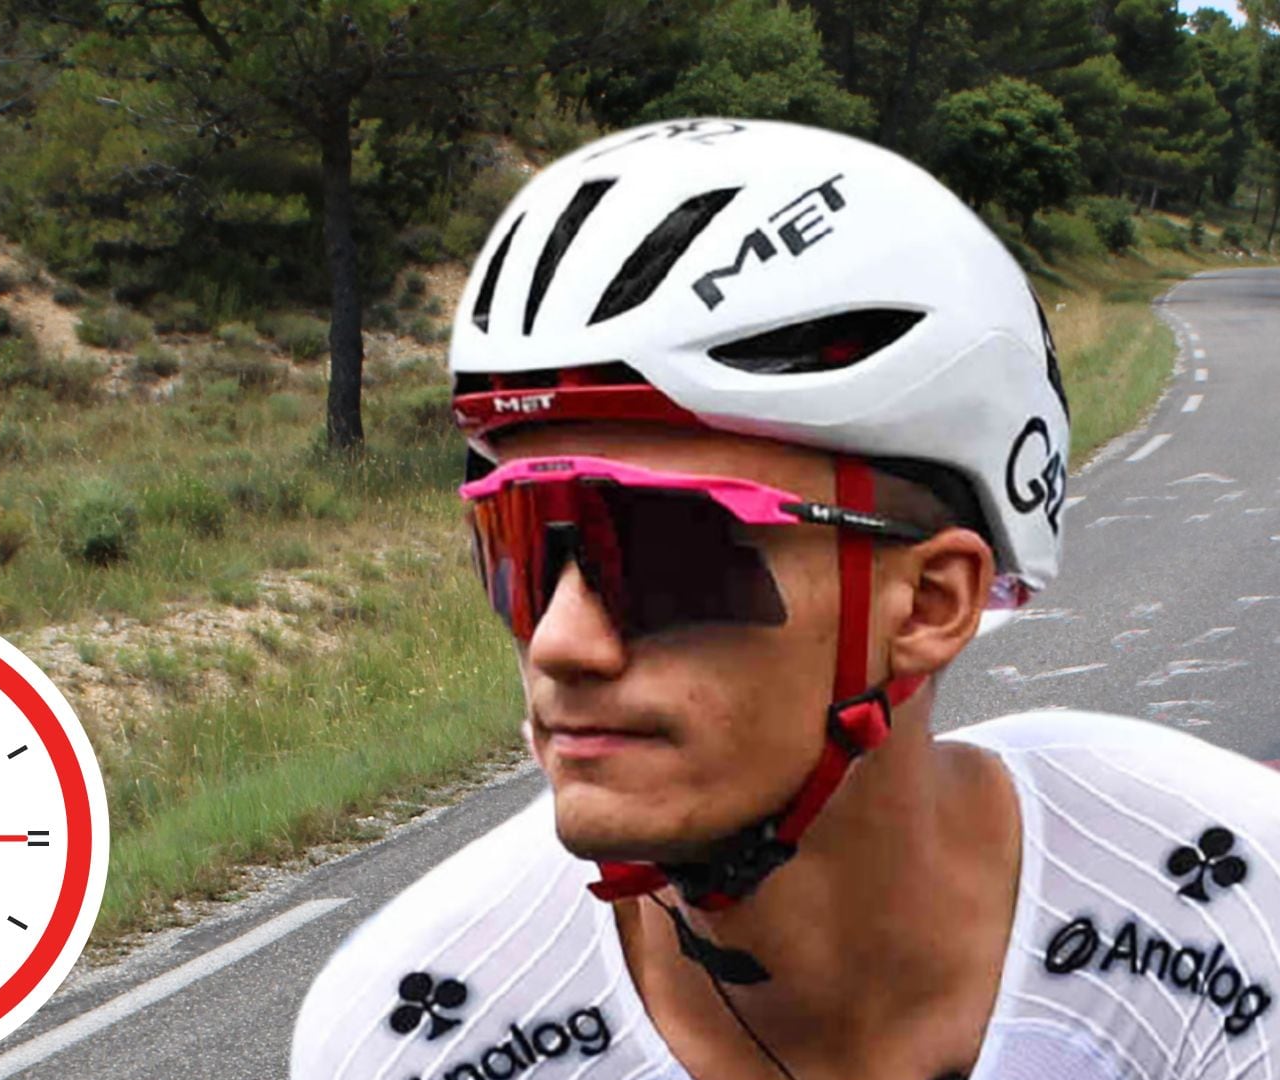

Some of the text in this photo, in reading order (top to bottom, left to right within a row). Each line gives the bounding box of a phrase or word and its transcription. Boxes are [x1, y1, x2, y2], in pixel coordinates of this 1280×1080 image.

[691, 173, 846, 312] MET
[493, 391, 556, 414] MET
[1098, 919, 1271, 1036] Analog
